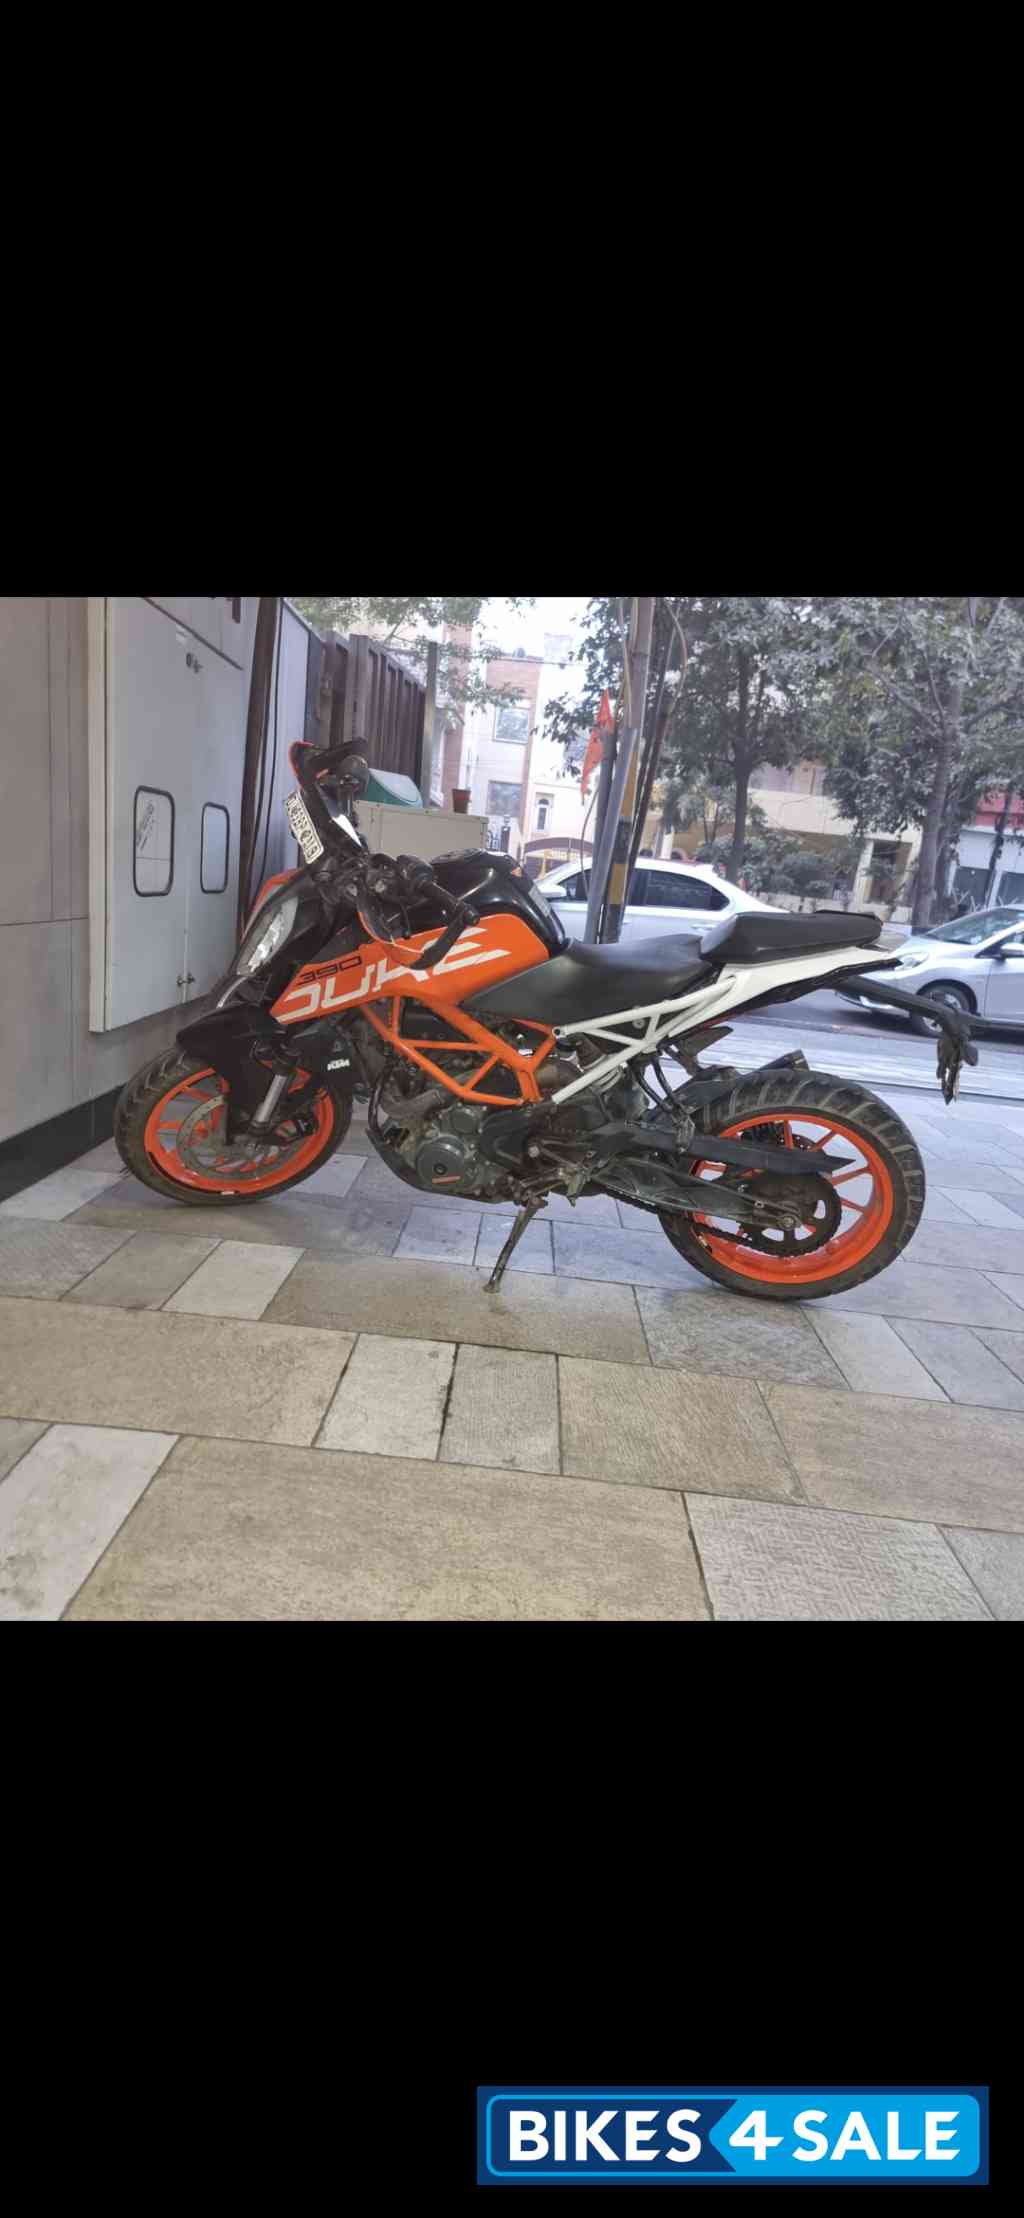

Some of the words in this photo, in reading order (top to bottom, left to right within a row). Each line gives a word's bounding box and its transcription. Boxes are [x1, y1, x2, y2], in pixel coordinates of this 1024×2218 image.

[275, 927, 512, 1022] DUKE
[296, 955, 362, 986] 390
[327, 1059, 350, 1071] KTM
